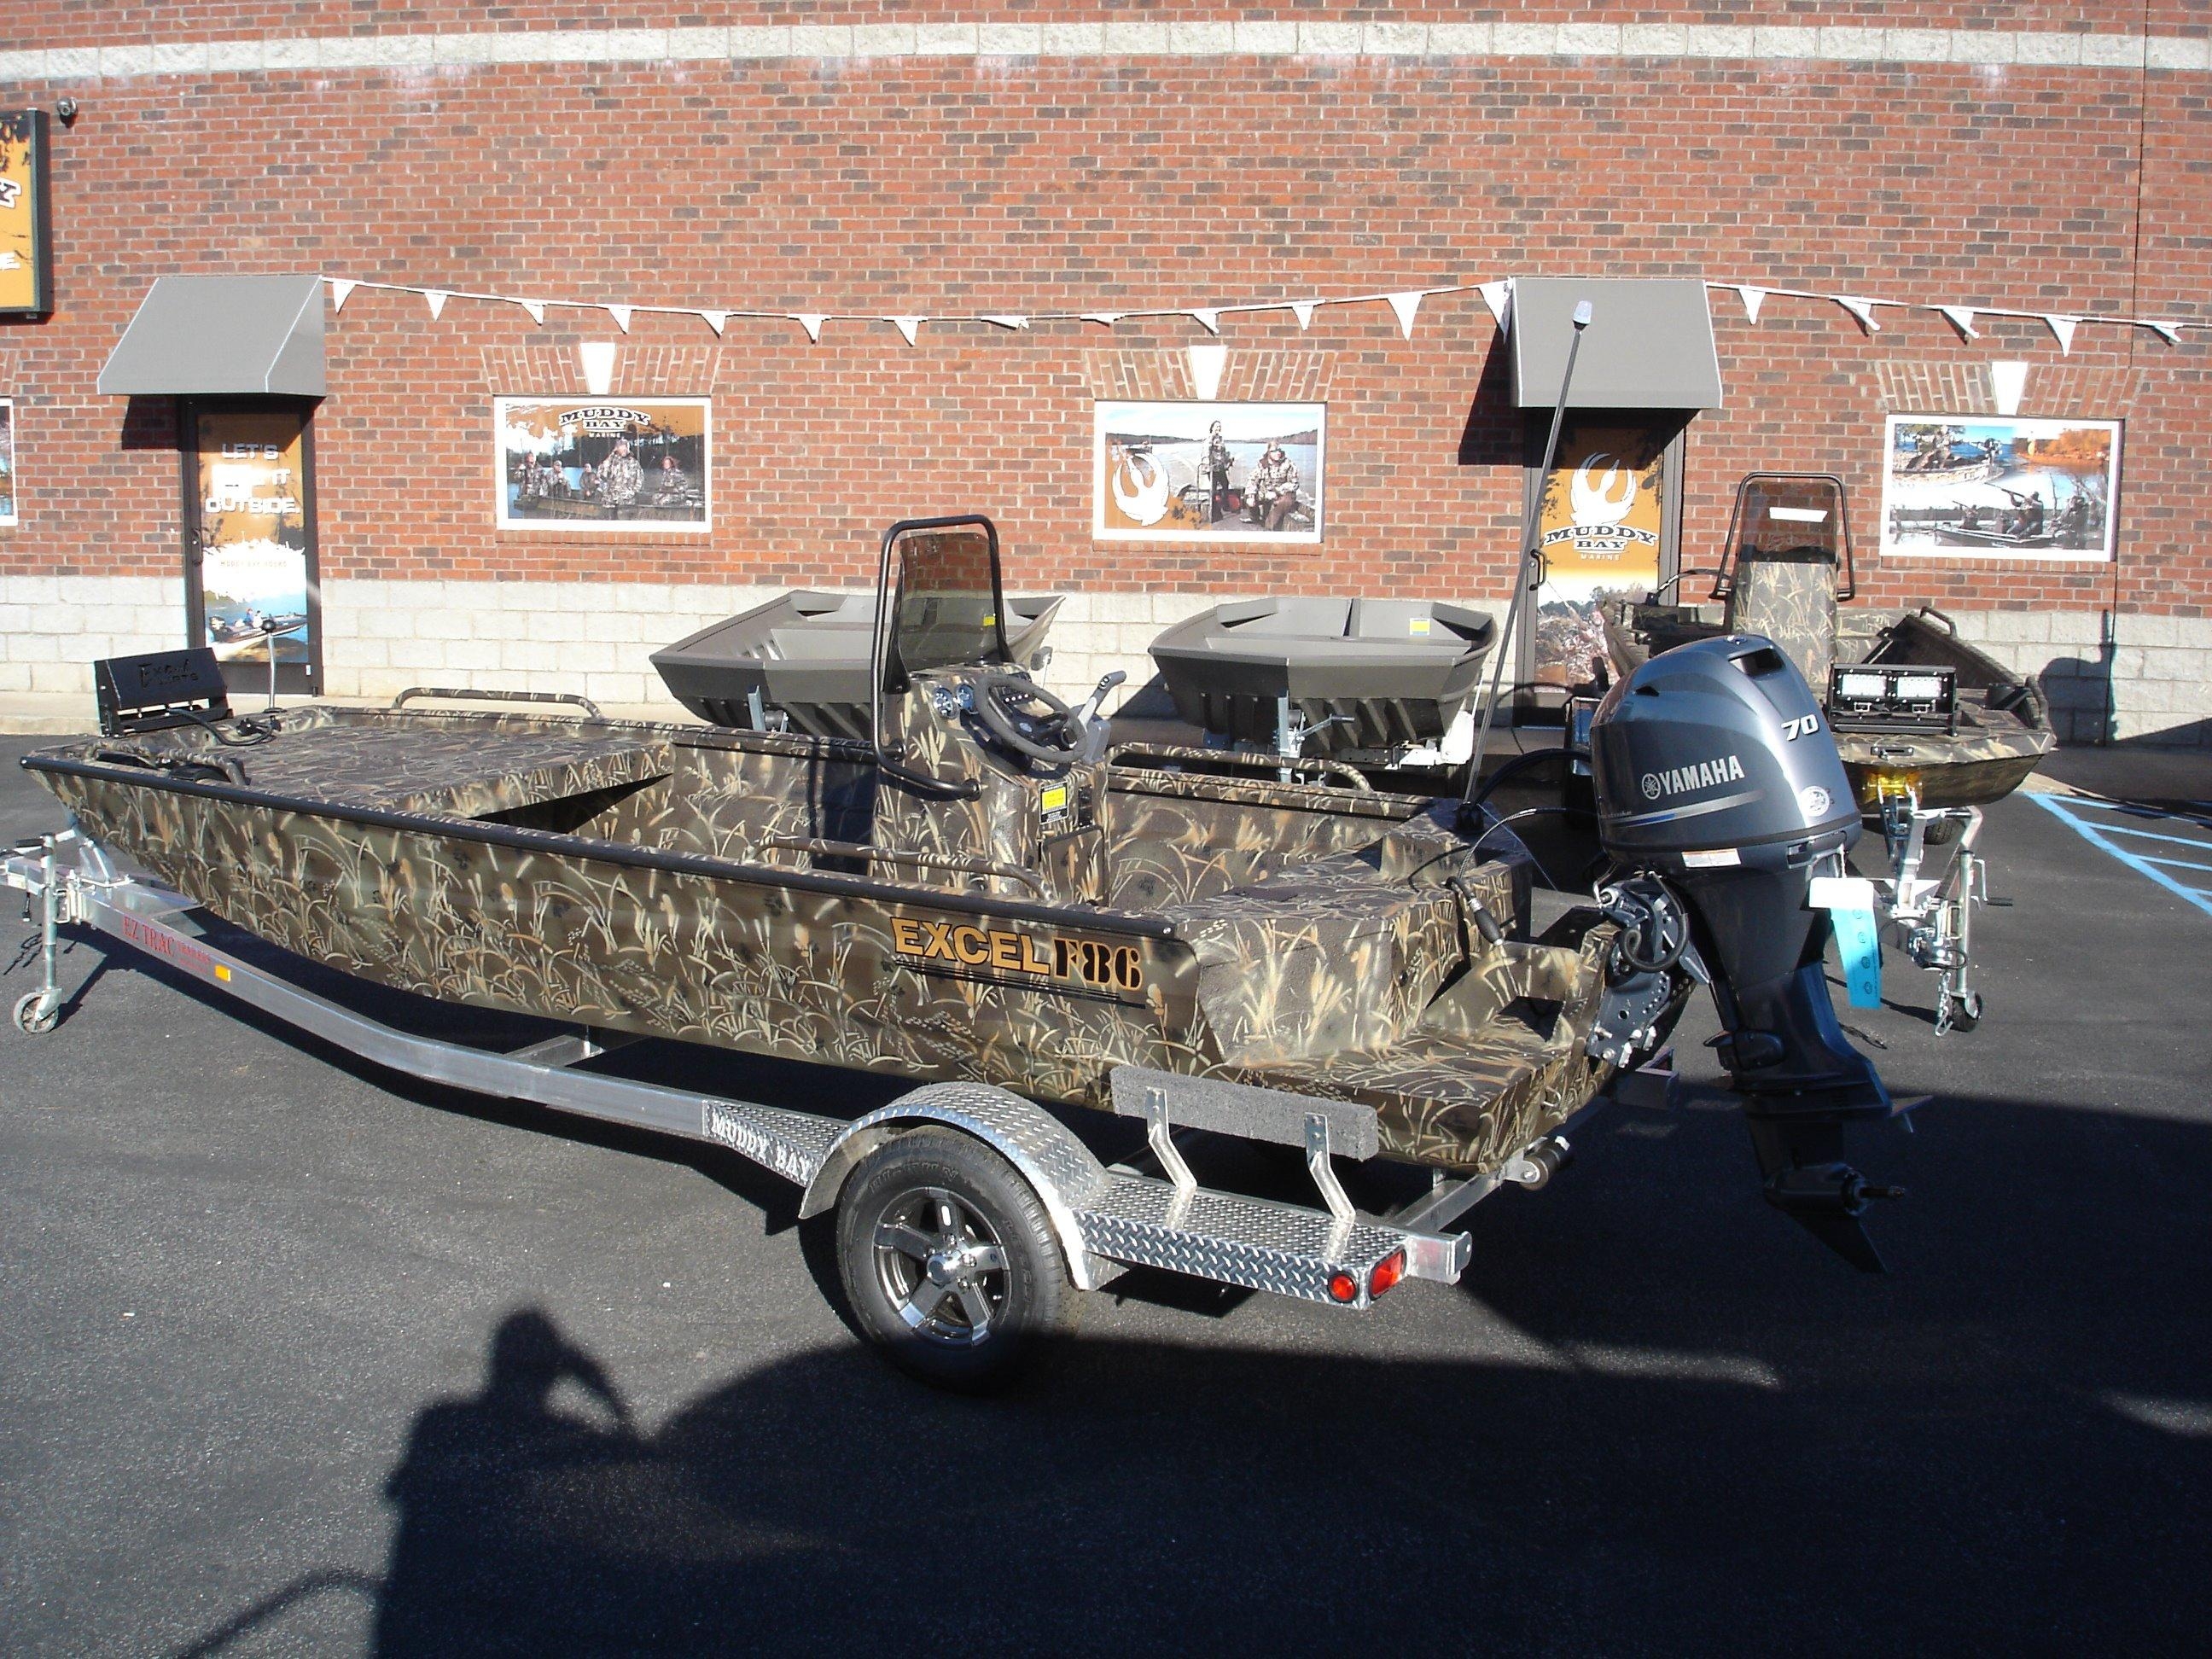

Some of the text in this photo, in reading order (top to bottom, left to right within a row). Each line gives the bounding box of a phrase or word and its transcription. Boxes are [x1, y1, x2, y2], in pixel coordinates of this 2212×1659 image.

[560, 407, 650, 426] MUDDY
[585, 420, 624, 428] BAY
[222, 443, 279, 460] LET'S
[205, 497, 300, 514] OUTSIDE.
[1545, 525, 1657, 544] MUDDY
[1575, 540, 1626, 549] BAY
[1780, 713, 1819, 742] 70
[1658, 755, 1745, 795] YAMAHA
[123, 916, 138, 940] EZ
[143, 924, 175, 957] TRAC
[890, 917, 1051, 975] EXCEL
[711, 1108, 812, 1184] MUDDY BAY
